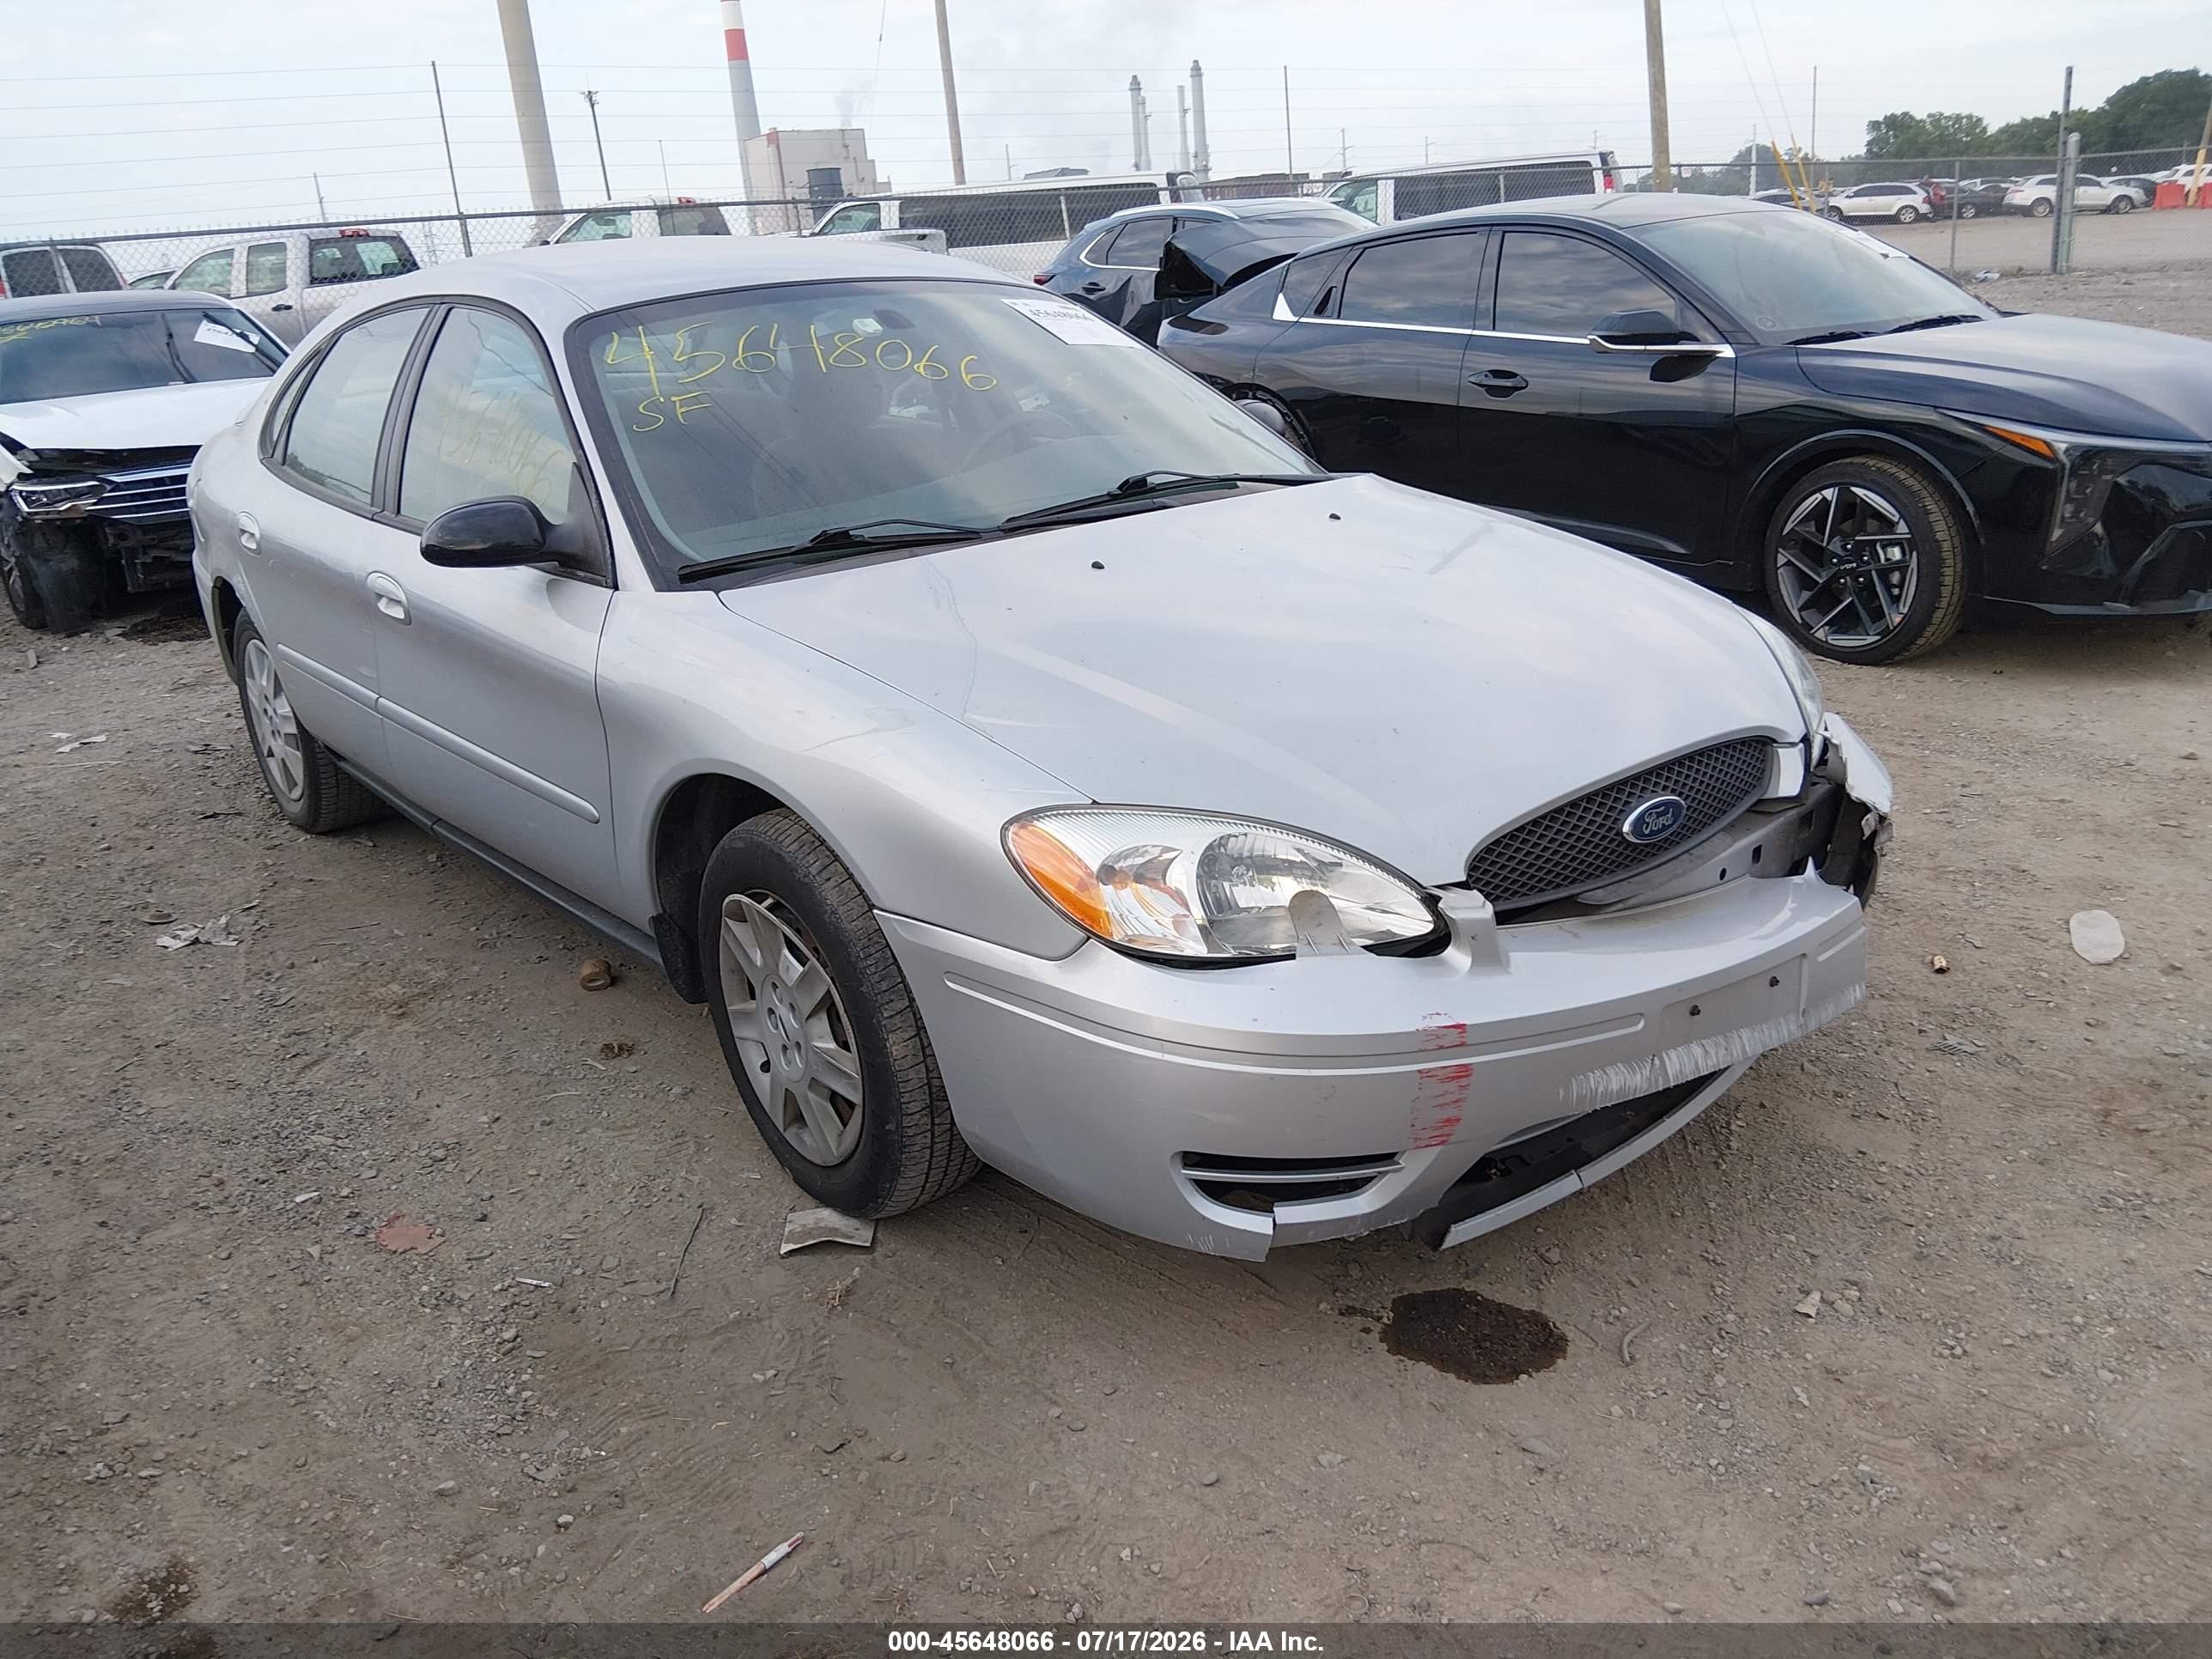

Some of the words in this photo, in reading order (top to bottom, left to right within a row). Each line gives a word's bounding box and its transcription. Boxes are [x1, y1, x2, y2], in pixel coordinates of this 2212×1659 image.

[606, 320, 998, 398] 45648066
[632, 391, 713, 432] SF
[1643, 806, 1674, 834] Ford
